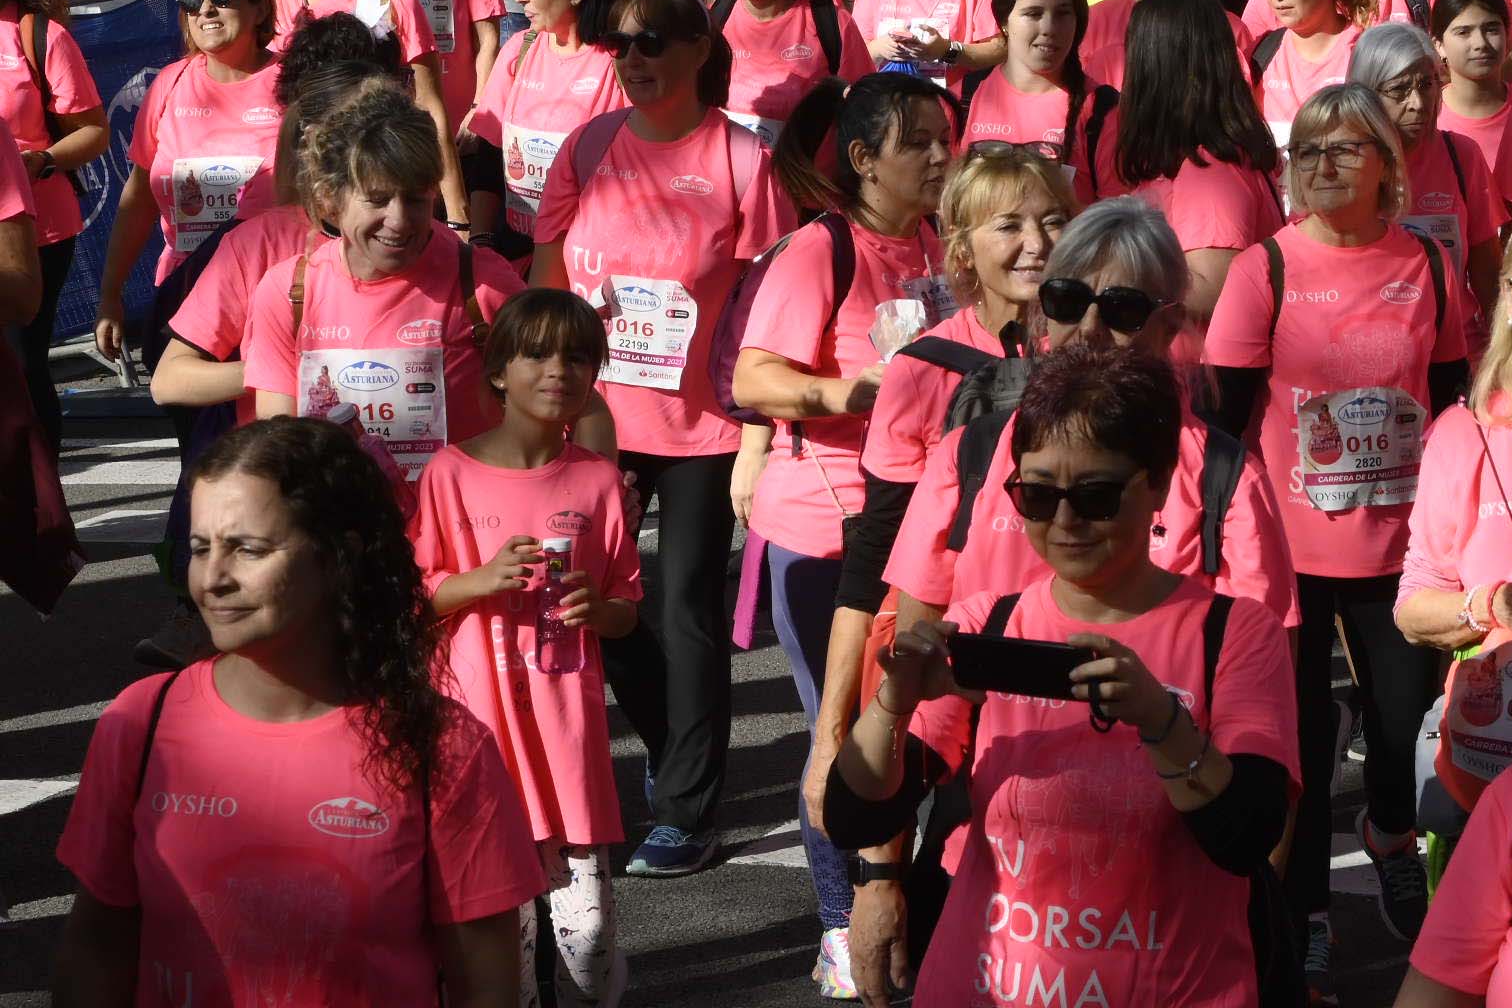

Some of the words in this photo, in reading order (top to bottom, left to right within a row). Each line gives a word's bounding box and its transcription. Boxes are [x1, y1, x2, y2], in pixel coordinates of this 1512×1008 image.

[971, 122, 1012, 135] OYSHO
[206, 193, 237, 208] 016
[616, 292, 657, 308] ASTURIANA
[1286, 290, 1340, 304] OYSHO
[616, 318, 654, 337] 016
[619, 339, 649, 351] 22199
[641, 356, 665, 364] MUJER
[405, 366, 433, 374] SUMA
[342, 372, 395, 384] ASTURIANA
[1343, 408, 1391, 419] ASTURIANA
[1346, 433, 1389, 453] 016
[1355, 456, 1382, 469] 2820
[1318, 473, 1353, 483] CARRERA
[1354, 473, 1366, 482] DE
[1315, 489, 1357, 502] OYSHO
[151, 792, 238, 817] OYSHO
[315, 809, 385, 832] ASTURIANA
[985, 893, 1164, 952] DORSAL
[974, 952, 1110, 1008] SUMA
